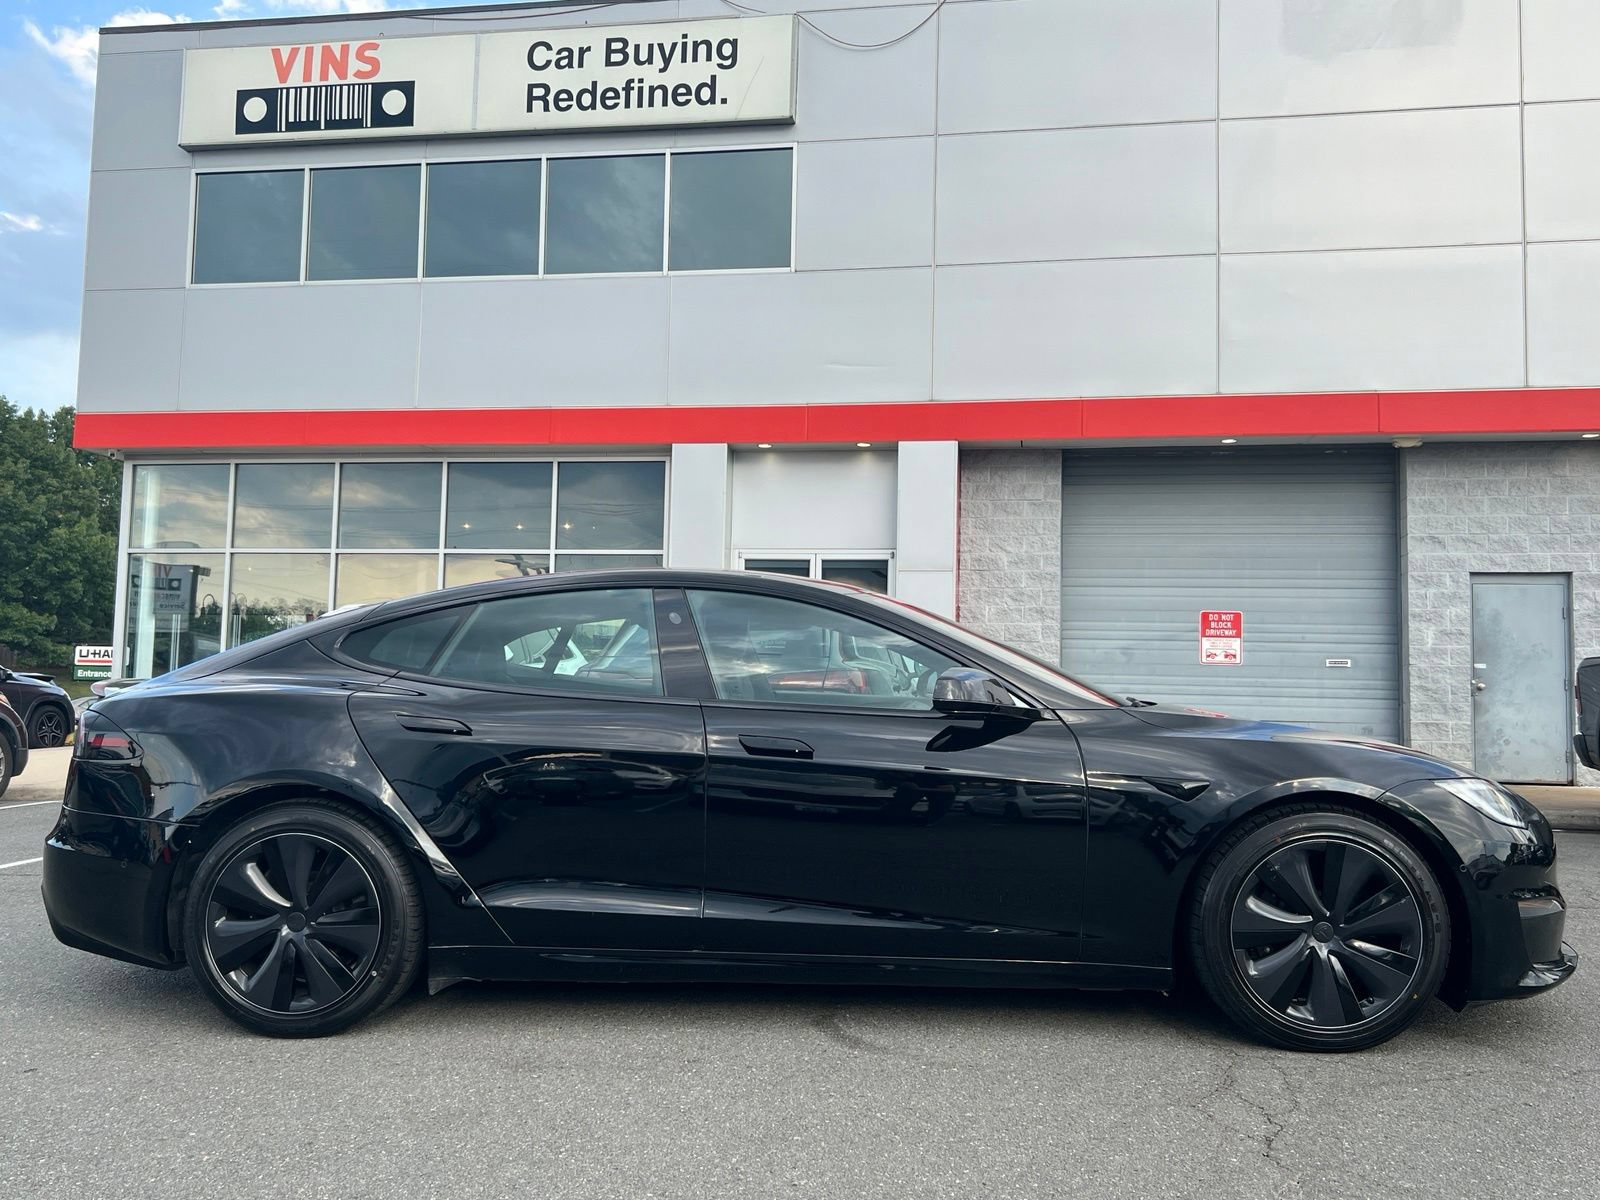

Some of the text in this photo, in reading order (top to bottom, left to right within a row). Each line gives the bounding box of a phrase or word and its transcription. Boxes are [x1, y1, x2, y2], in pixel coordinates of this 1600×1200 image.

[271, 42, 380, 84] VINS
[527, 33, 739, 74] Car Buying
[526, 74, 728, 114] Redefined.
[1210, 621, 1232, 629] BLOCK
[79, 649, 113, 659] U-HA
